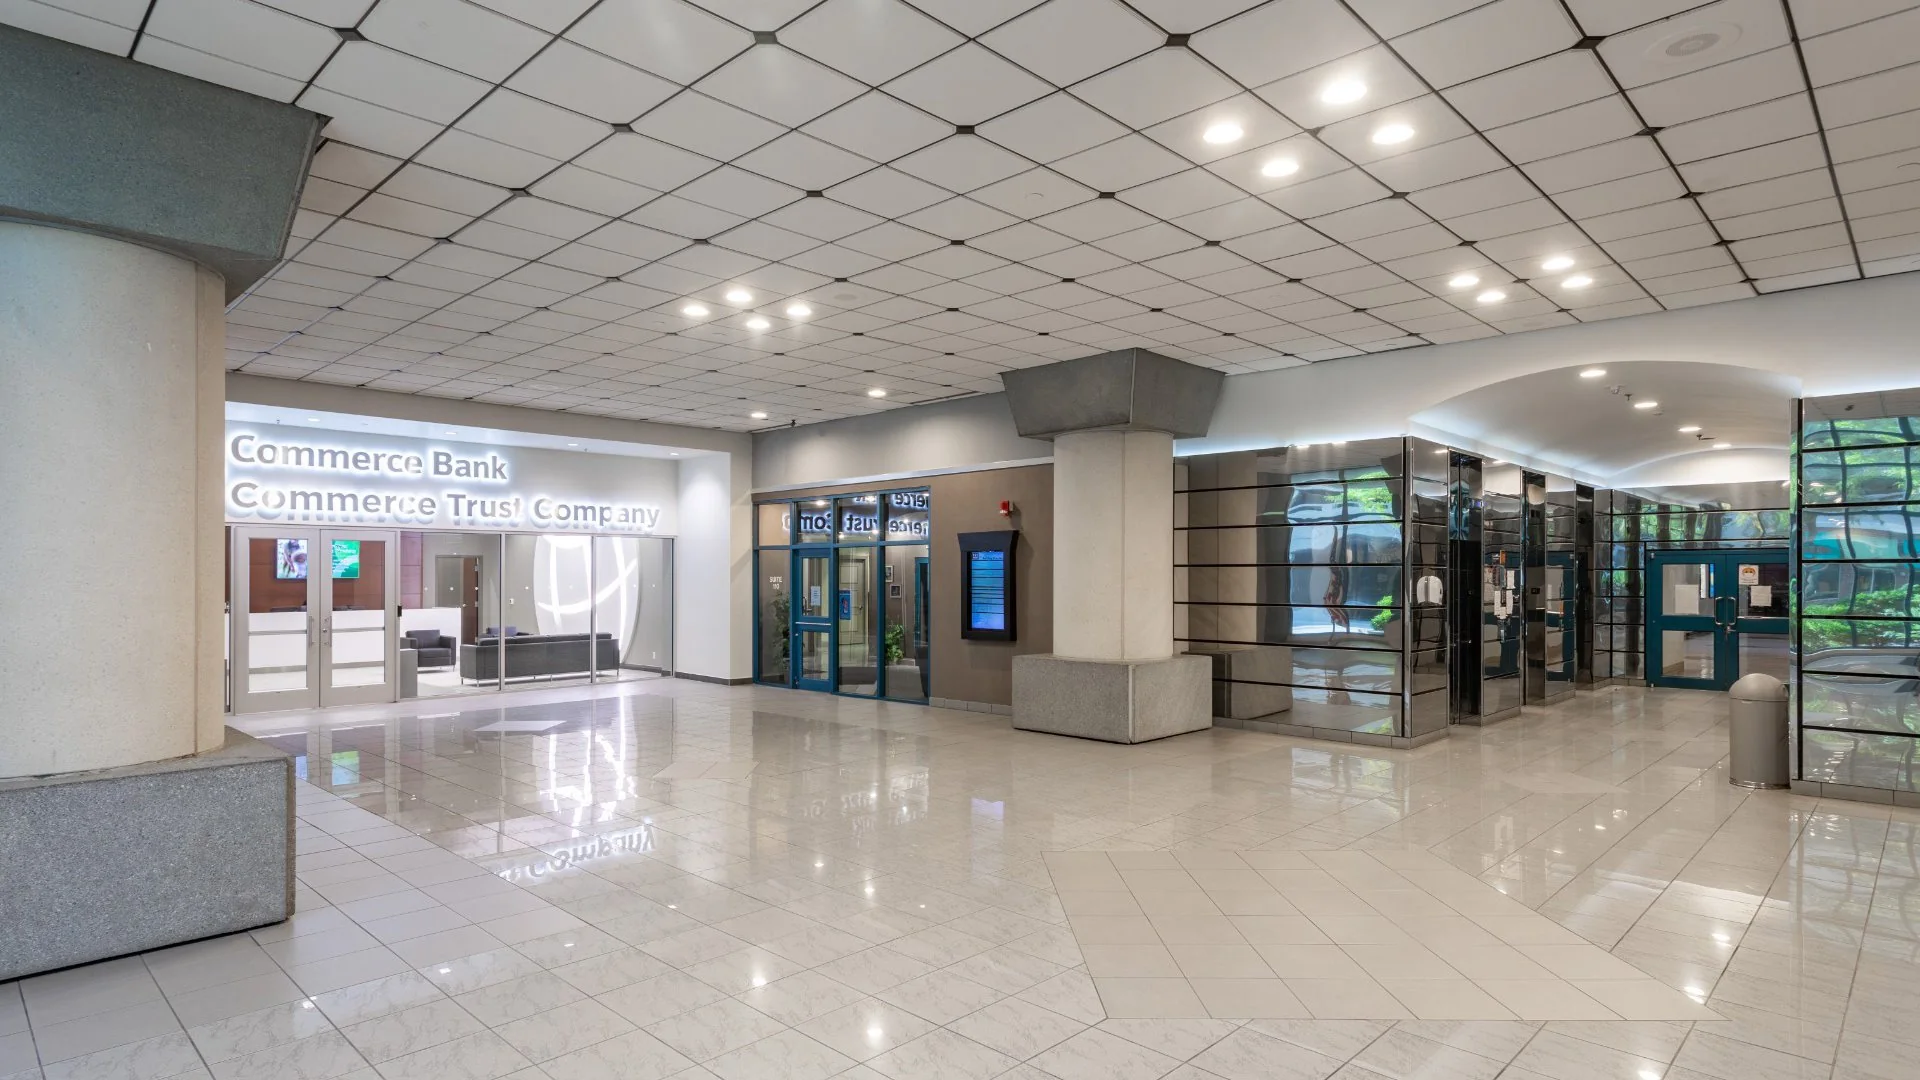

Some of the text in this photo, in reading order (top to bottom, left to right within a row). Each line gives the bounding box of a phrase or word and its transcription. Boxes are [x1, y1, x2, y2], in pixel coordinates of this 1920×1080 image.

[231, 434, 508, 480] Commerce Bank
[231, 482, 660, 527] Commerce Trust Company
